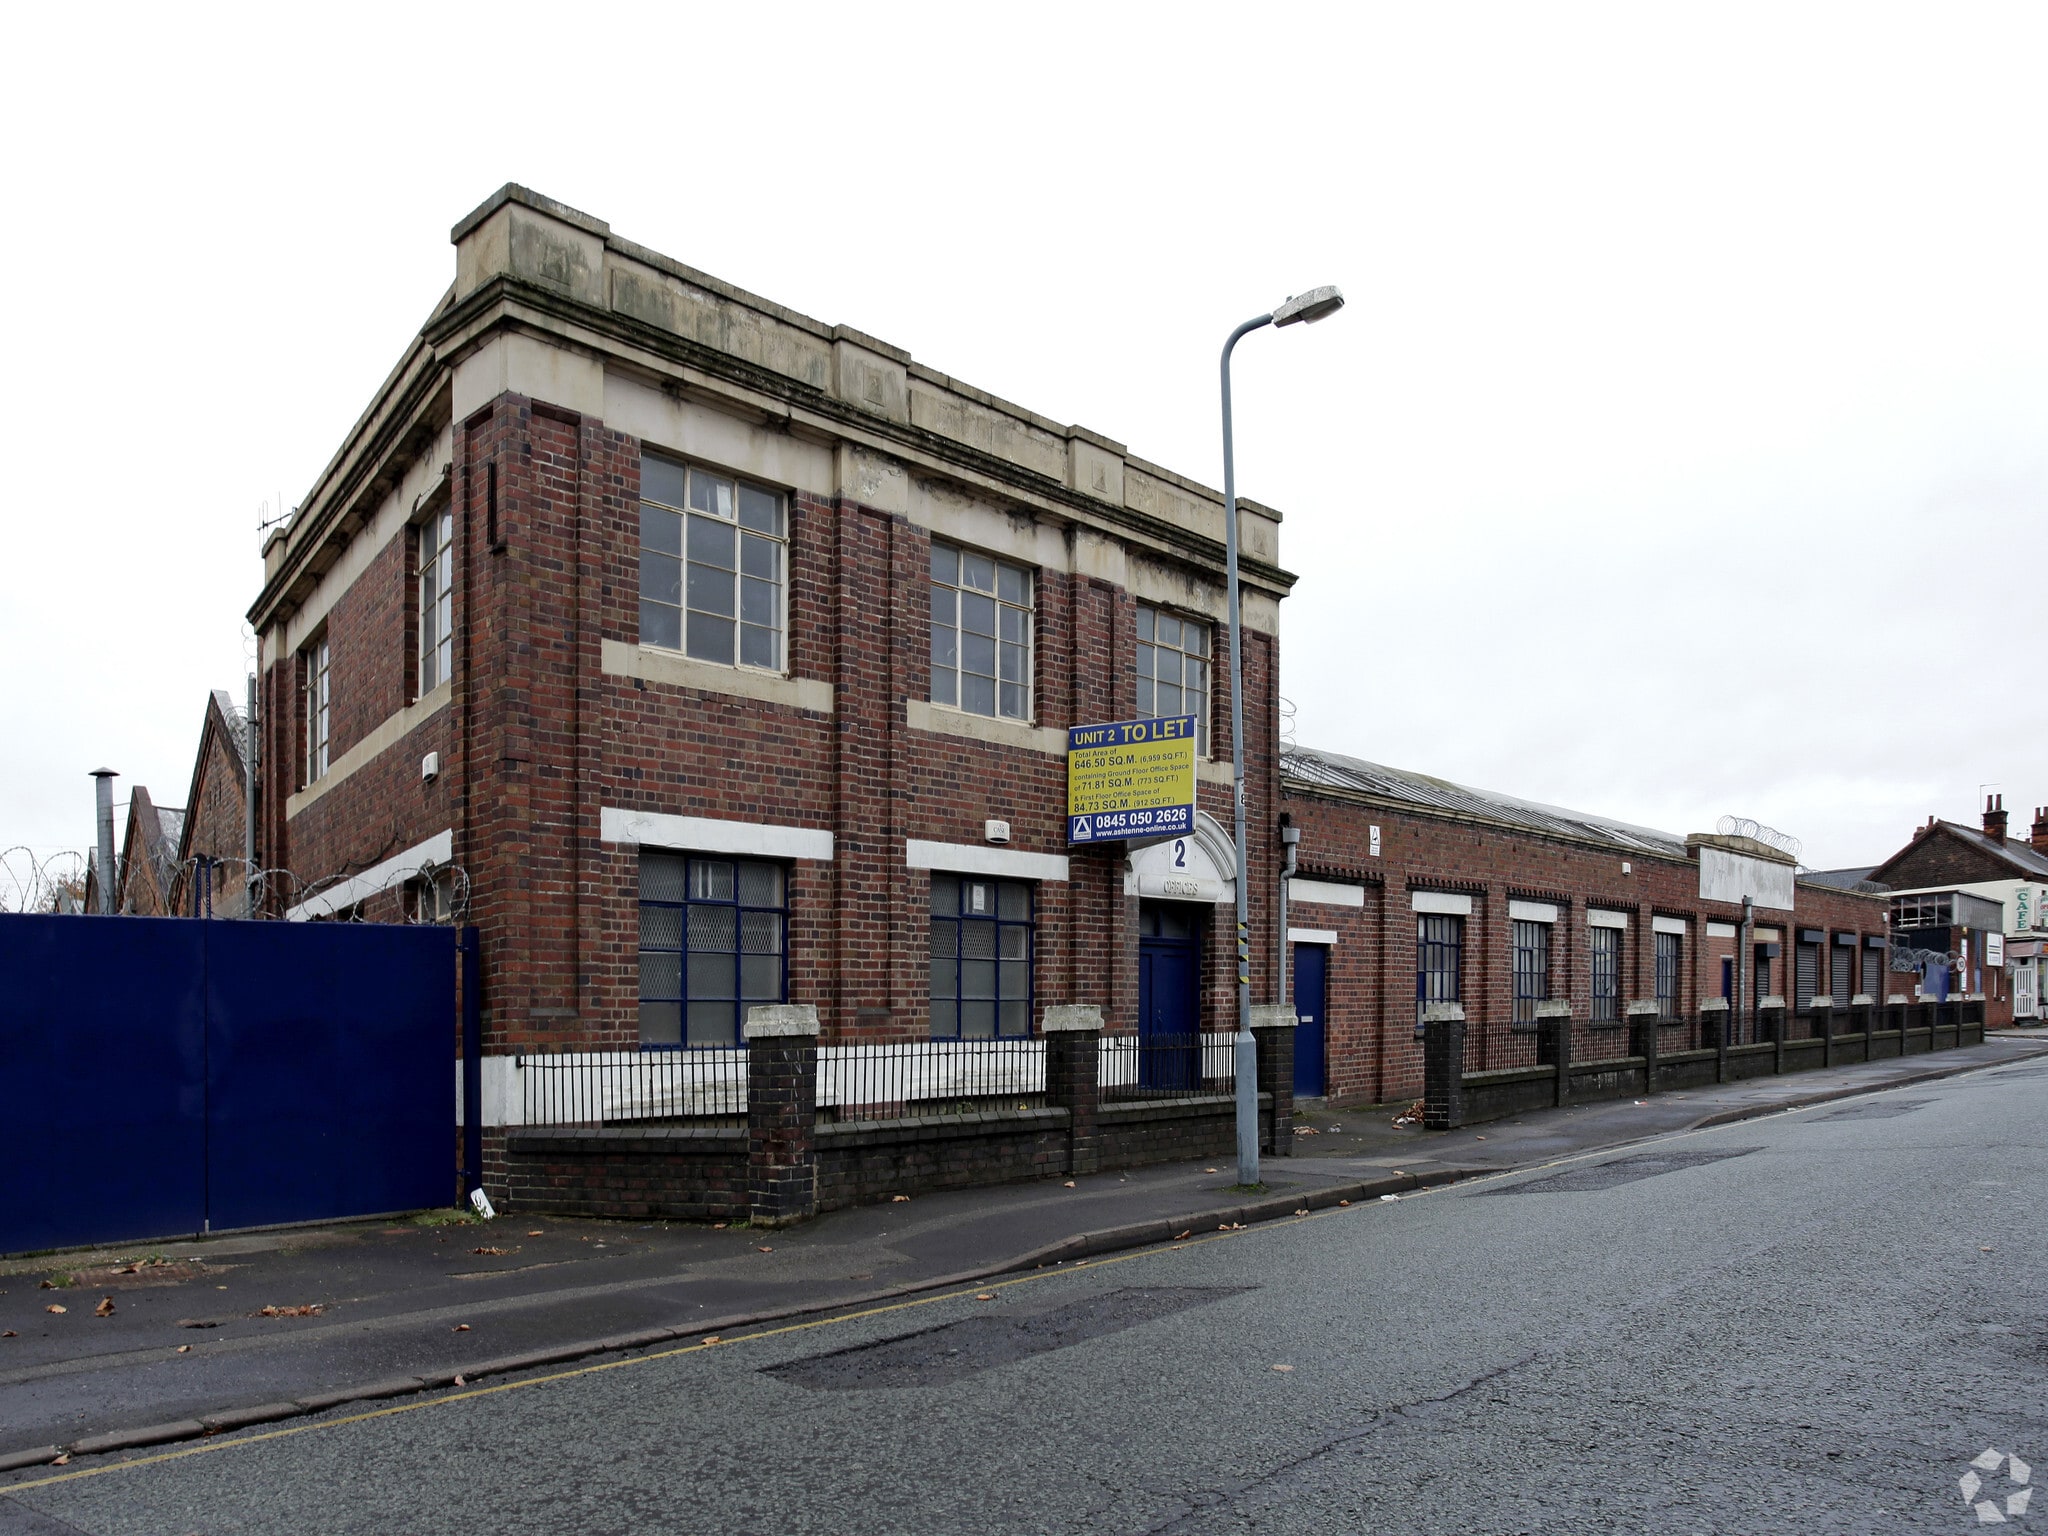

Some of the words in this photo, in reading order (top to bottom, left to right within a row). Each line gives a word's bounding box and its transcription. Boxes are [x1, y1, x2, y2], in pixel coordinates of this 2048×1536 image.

[1075, 731, 1104, 744] UNIT
[1108, 730, 1114, 741] 2
[1121, 724, 1146, 742] TO
[1153, 719, 1188, 739] LET
[1075, 758, 1105, 769] 646.50
[1109, 755, 1136, 766] SQ.M.
[1075, 772, 1106, 780] containing
[1108, 768, 1131, 776] Ground
[1133, 766, 1148, 774] Floor
[1170, 764, 1189, 772] Space
[1082, 781, 1104, 790] 71.81
[1109, 778, 1134, 788] SQ.M.
[1133, 789, 1151, 797] Space
[1074, 801, 1099, 812] 84.73
[1103, 799, 1130, 809] SQ.M.
[1096, 814, 1126, 828] 0845
[1130, 812, 1152, 825] 050
[1156, 808, 1186, 822] 2626
[1175, 840, 1185, 867] 2
[2016, 893, 2028, 929] CAFE
